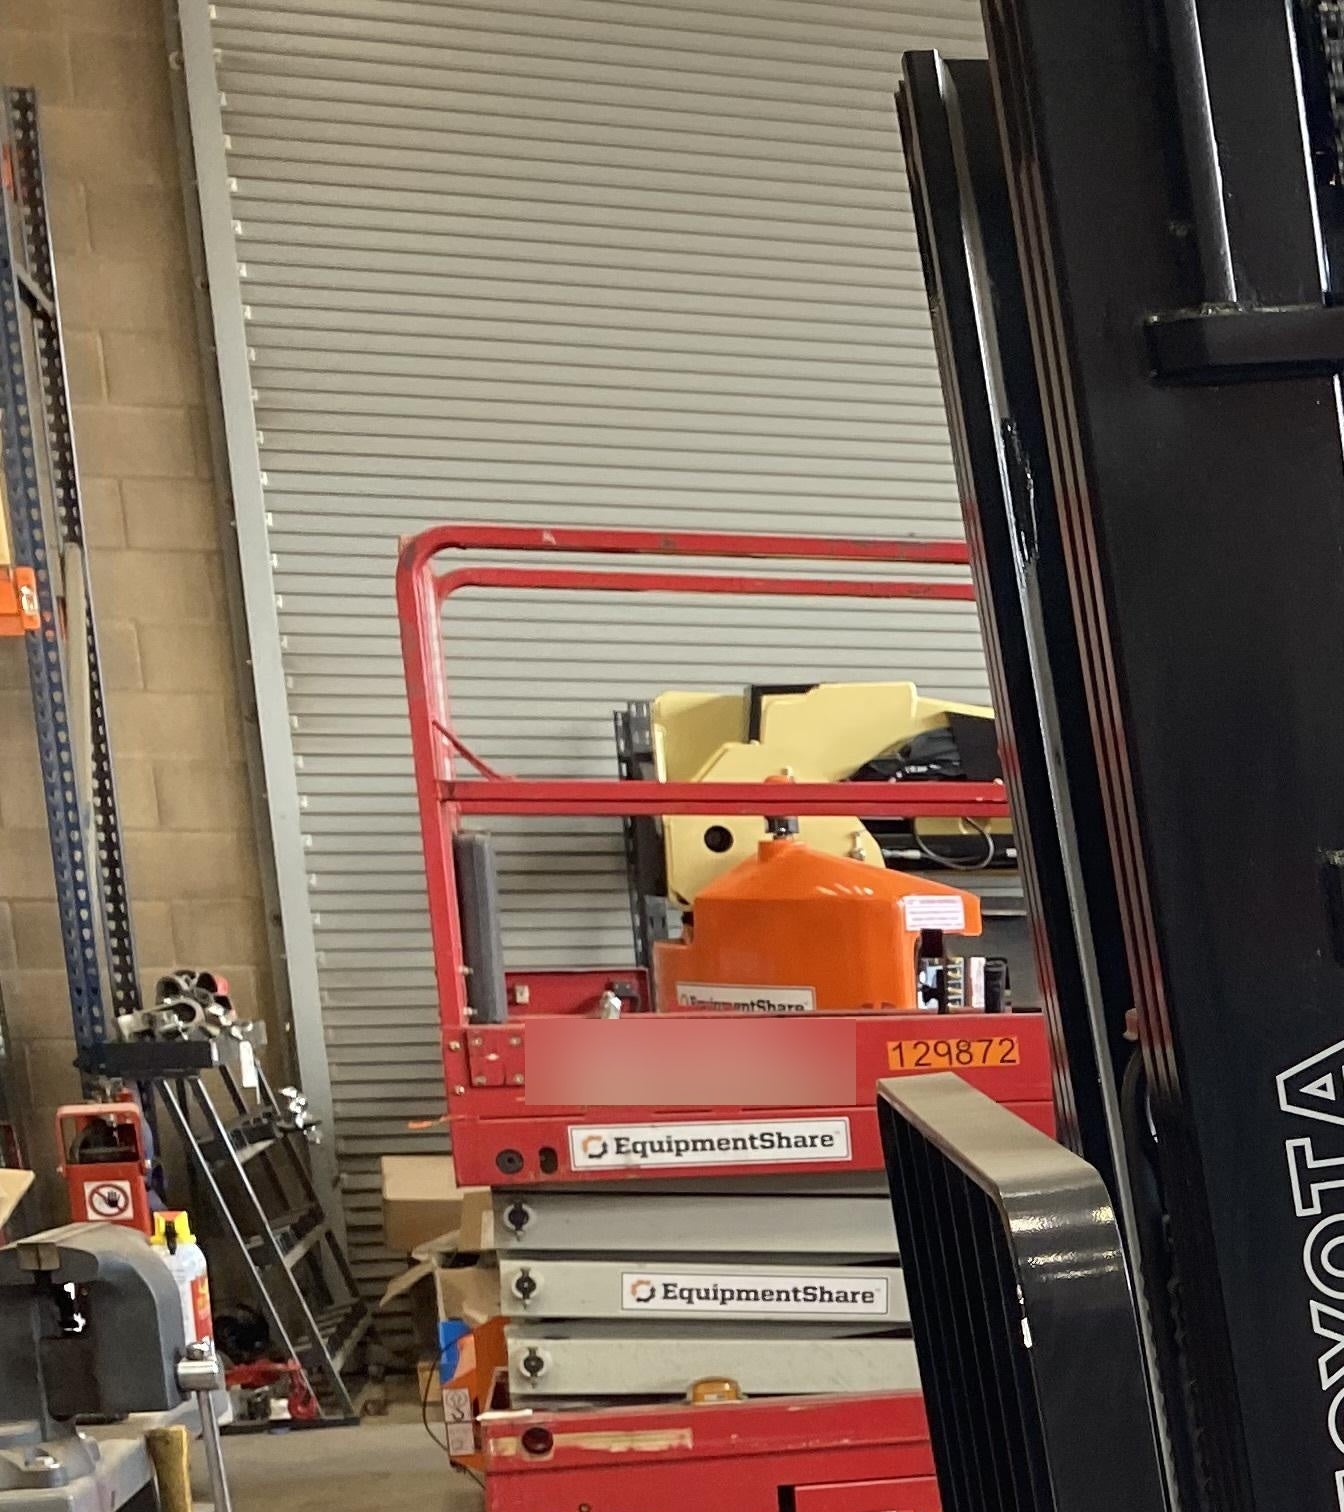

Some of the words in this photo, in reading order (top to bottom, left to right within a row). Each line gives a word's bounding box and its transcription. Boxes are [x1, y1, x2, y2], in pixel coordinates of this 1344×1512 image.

[892, 1037, 1017, 1068] 129872
[613, 1132, 835, 1159] EquipmentShare
[661, 1282, 875, 1305] EquipmentShare
